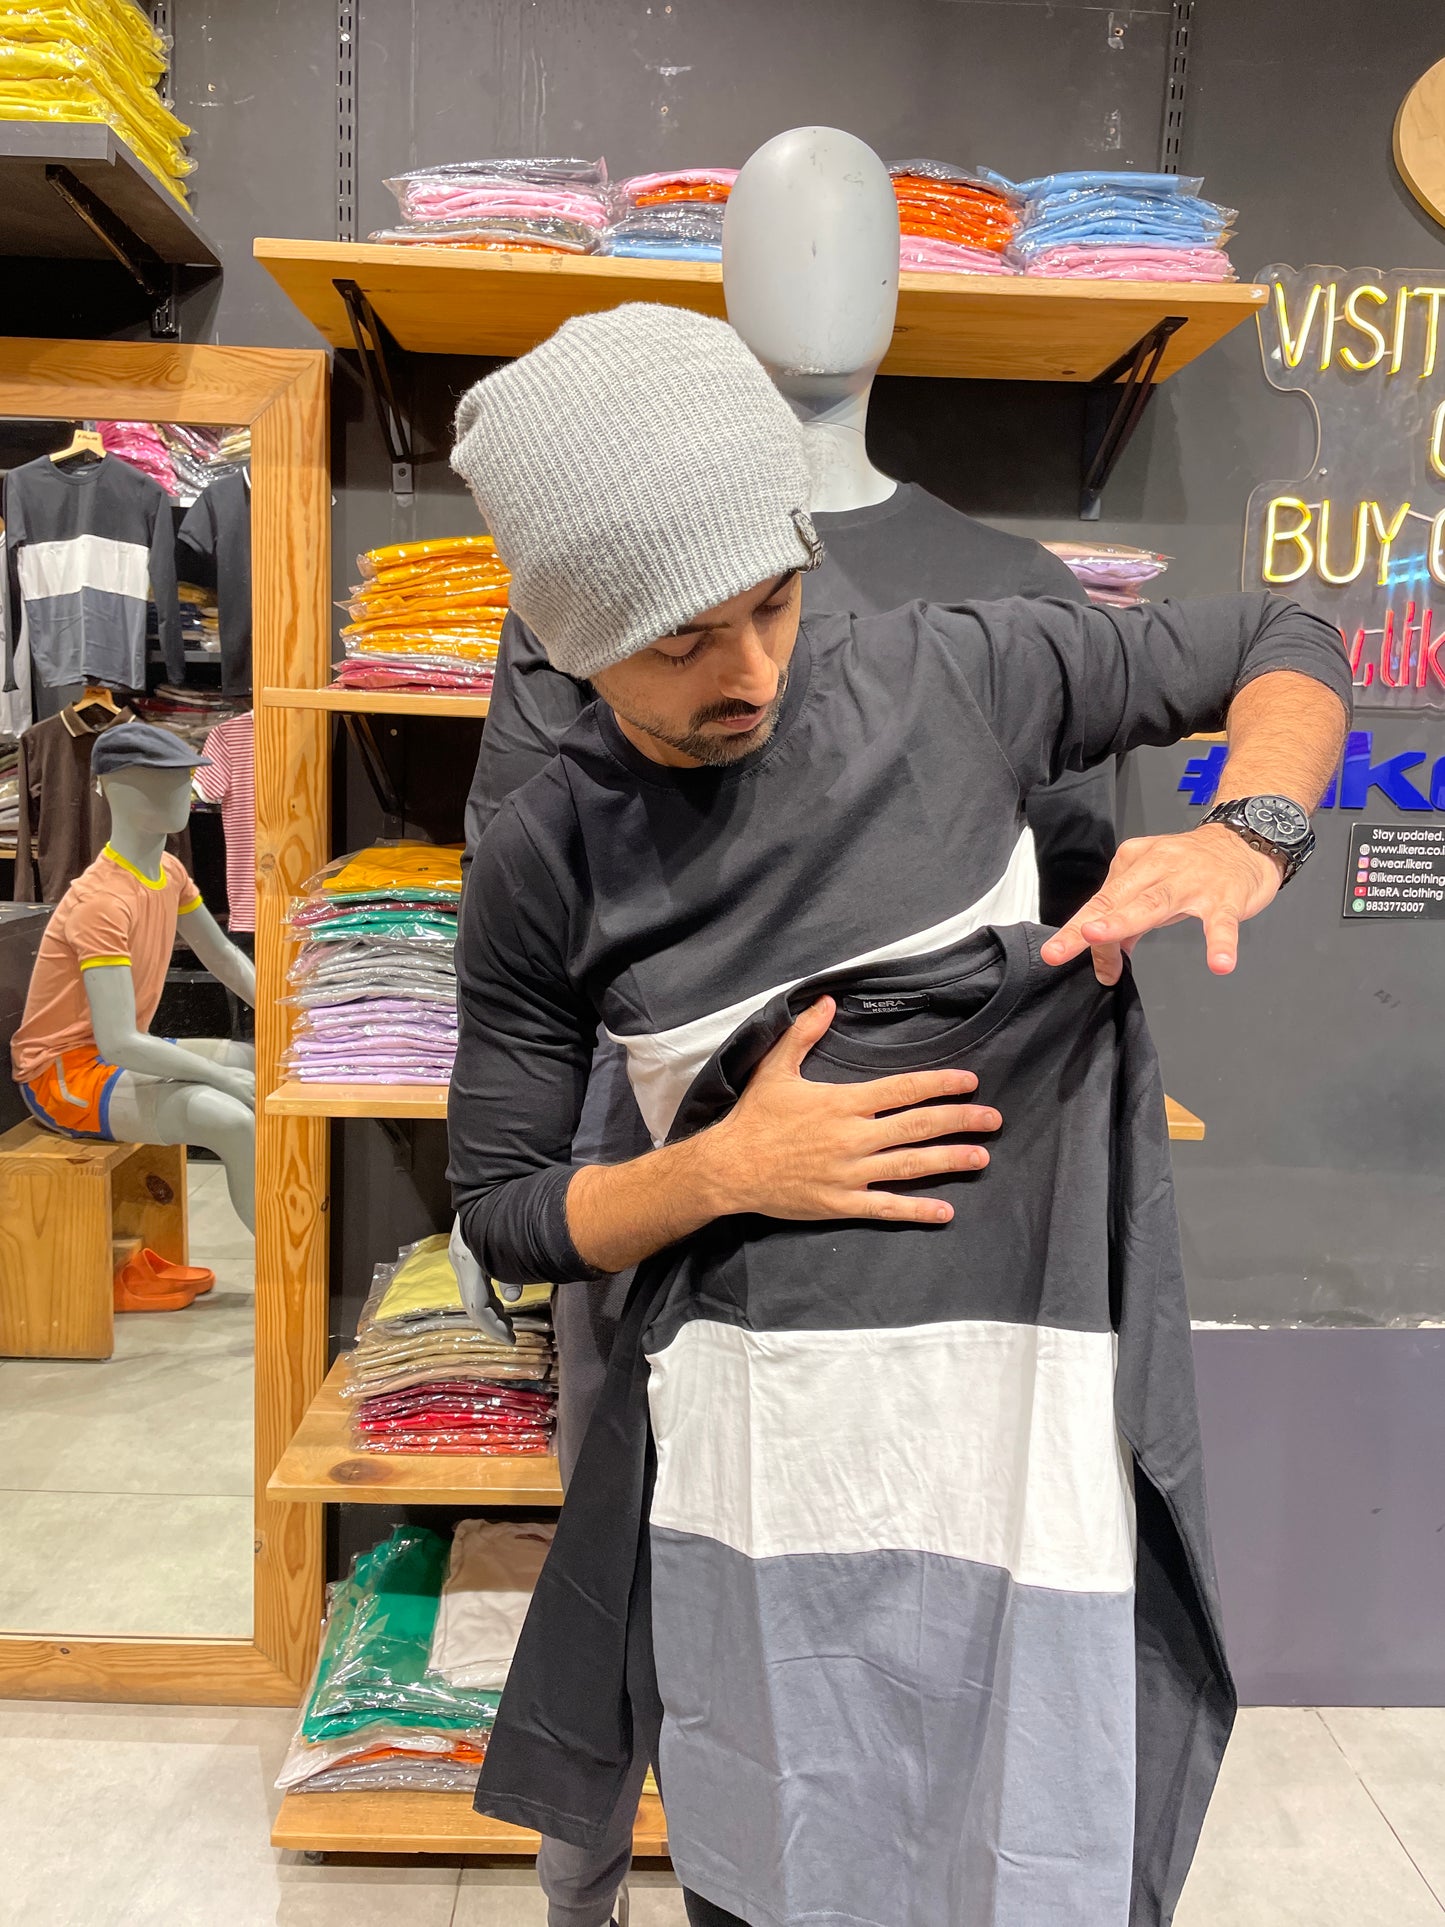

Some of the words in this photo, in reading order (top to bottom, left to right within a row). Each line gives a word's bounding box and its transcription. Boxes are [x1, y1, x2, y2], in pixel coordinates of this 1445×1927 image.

[1274, 281, 1445, 379] VISIT
[1263, 496, 1412, 584] BUY
[1372, 829, 1395, 842] Stay
[1397, 830, 1445, 842] updated.
[1370, 857, 1432, 869] @wear.likera
[1367, 887, 1399, 897] LikeRA
[1402, 888, 1443, 900] clothing
[1366, 902, 1424, 912] 9833773007
